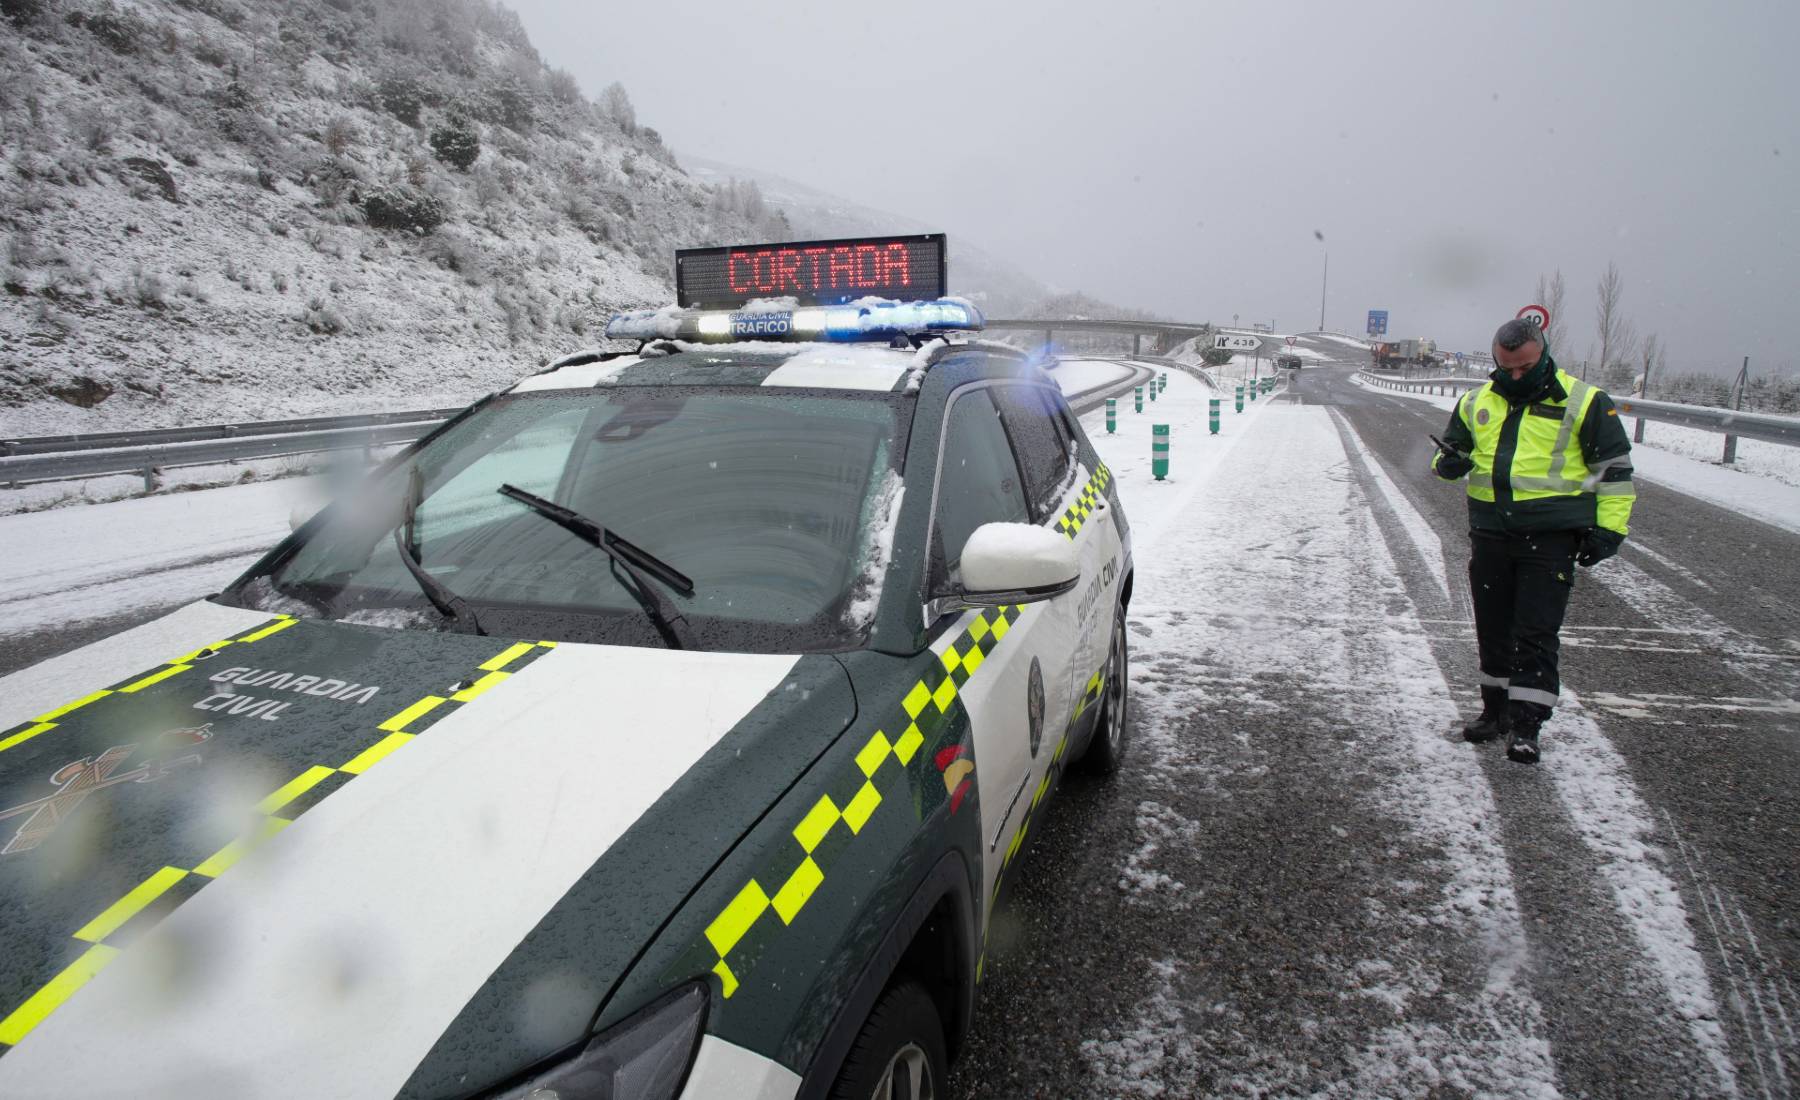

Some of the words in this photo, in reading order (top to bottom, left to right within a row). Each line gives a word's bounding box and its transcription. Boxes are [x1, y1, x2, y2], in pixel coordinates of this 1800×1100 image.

[728, 243, 911, 293] CORTADA
[730, 320, 788, 334] TRAFICO
[768, 311, 791, 320] CIVIL
[208, 666, 380, 705] GUARDIA
[192, 692, 292, 721] CIVIL
